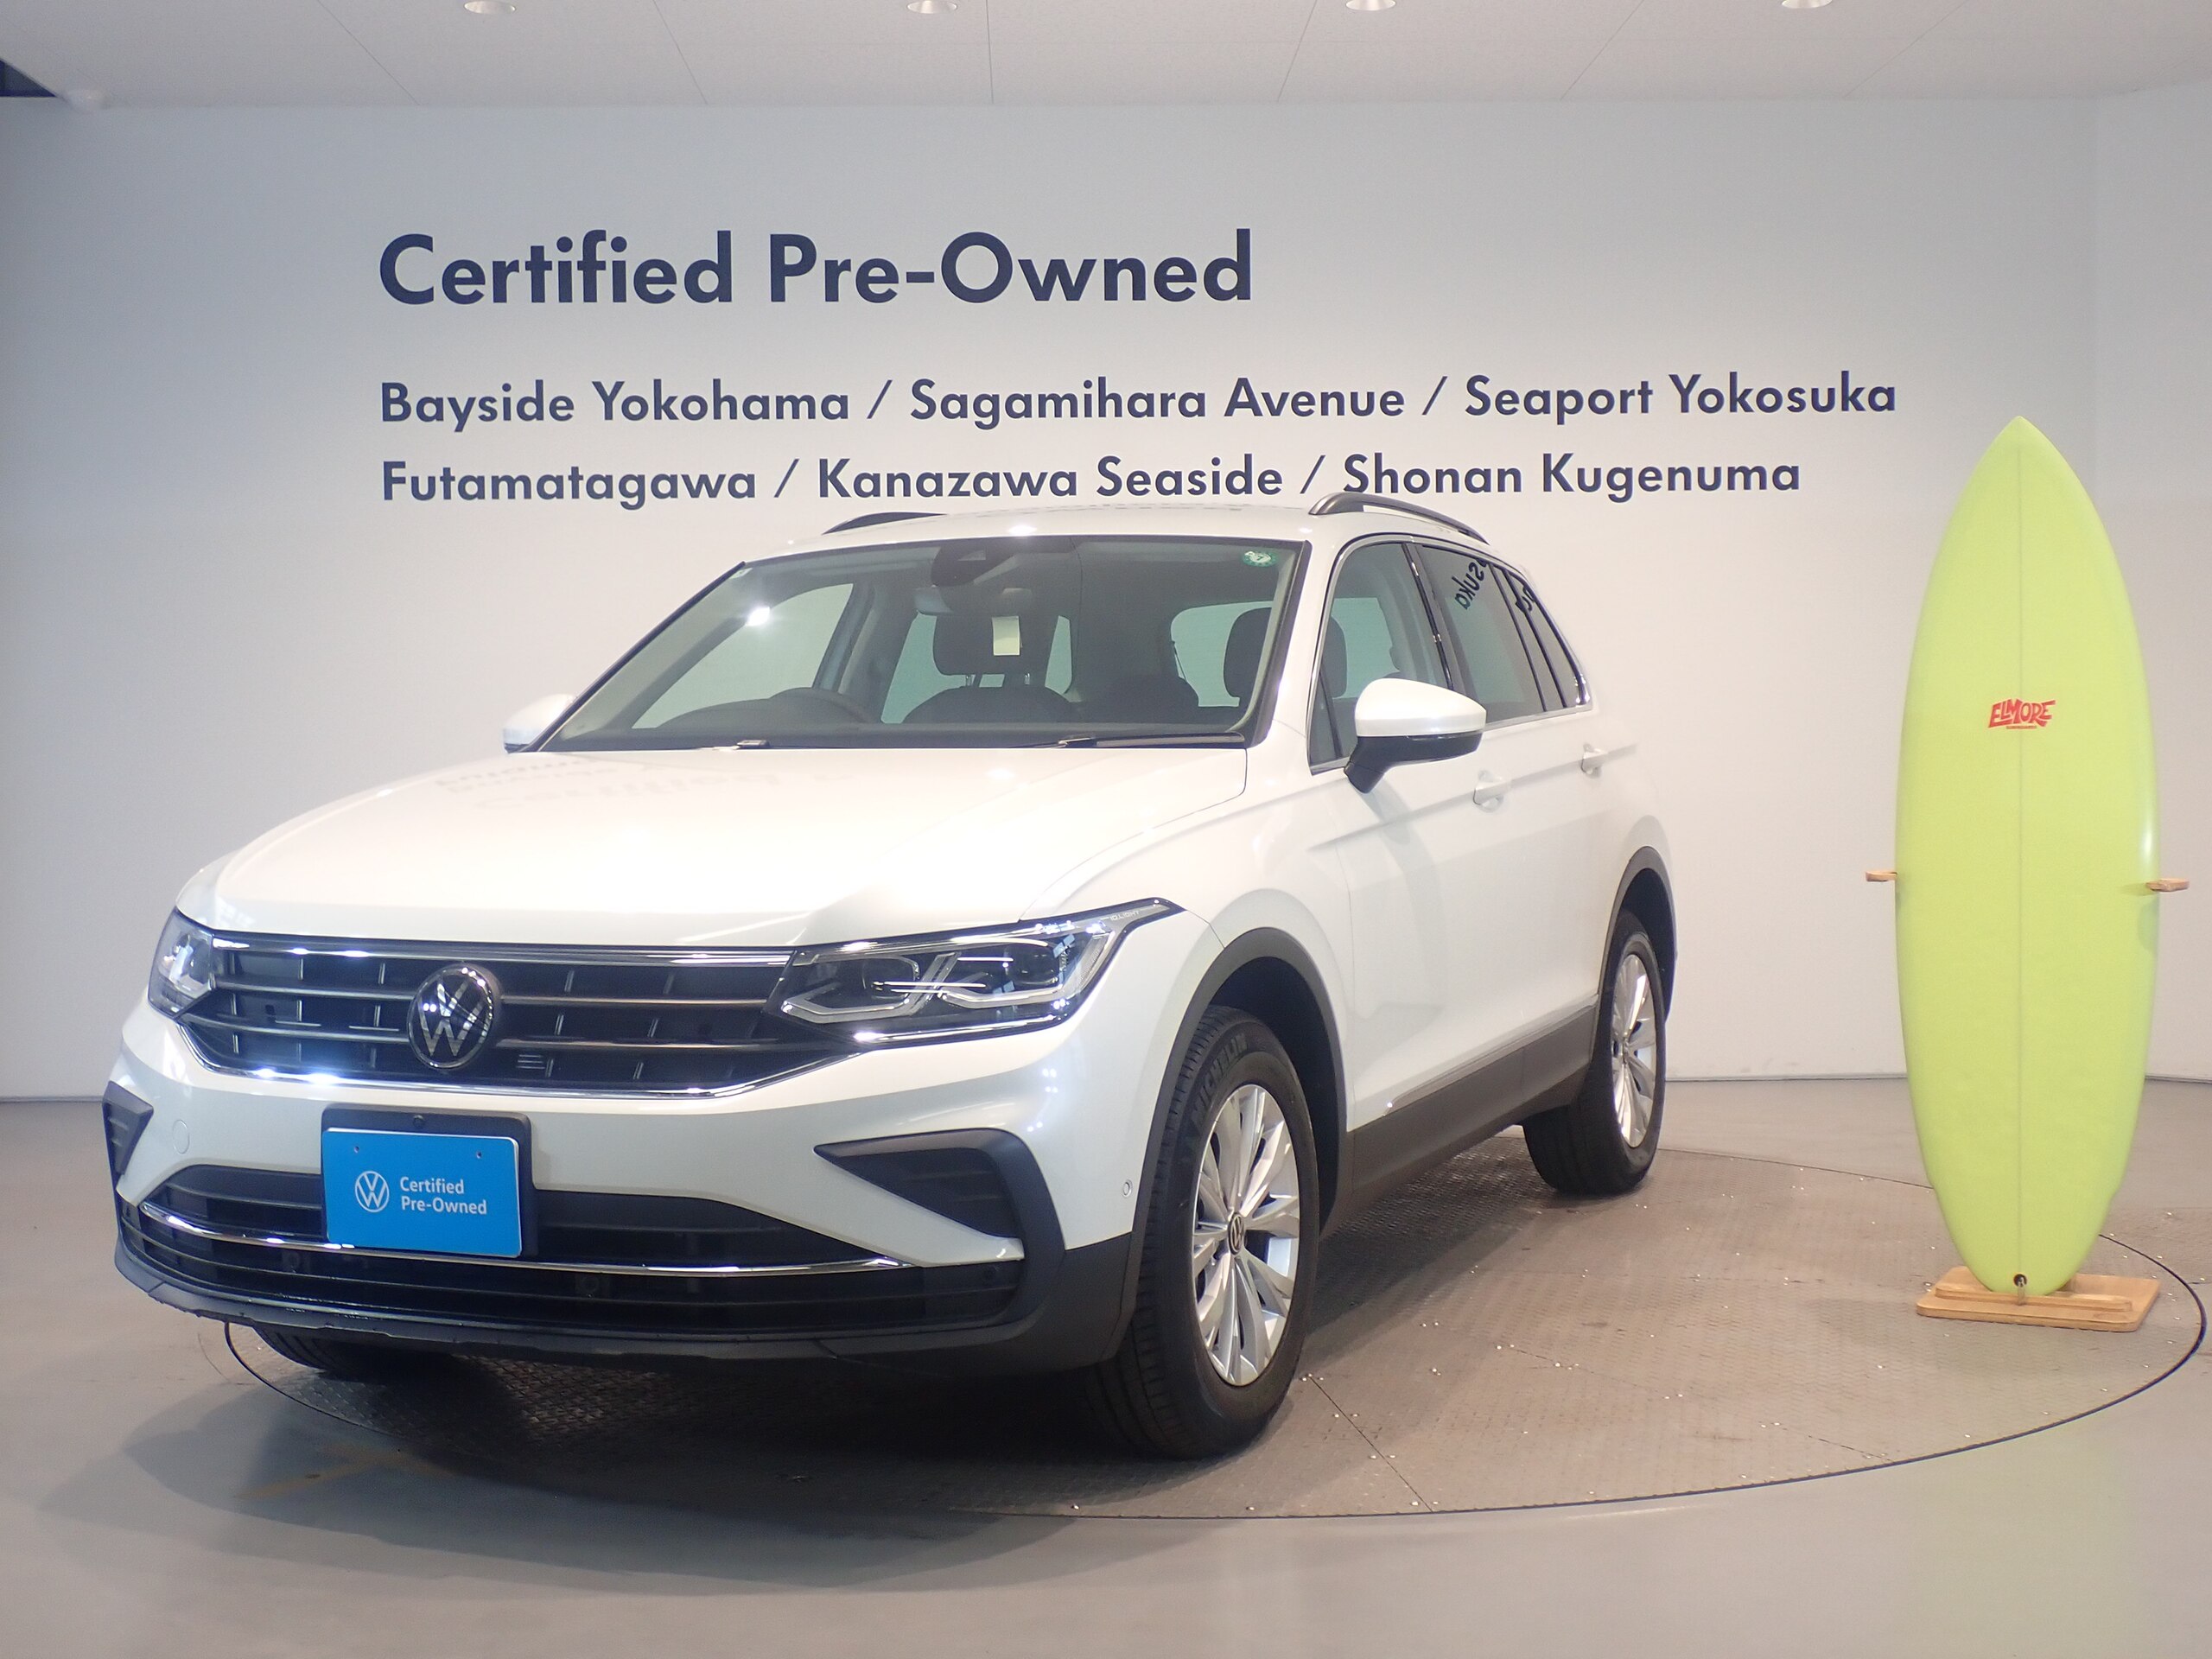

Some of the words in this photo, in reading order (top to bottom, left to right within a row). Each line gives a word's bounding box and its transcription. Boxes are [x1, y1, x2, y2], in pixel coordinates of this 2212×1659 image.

[380, 229, 733, 306] Certified
[769, 228, 1251, 304] Pre-Owned
[381, 379, 575, 433] Bayside
[591, 378, 849, 422] Yokohama
[867, 379, 893, 419] /
[910, 376, 1205, 430] Sagamihara
[1224, 377, 1405, 417] Avenue
[1421, 376, 1448, 416] /
[1465, 374, 1654, 426] Seaport
[1668, 370, 1896, 414] Yokosuka
[383, 461, 755, 511] Futamatagawa
[773, 458, 799, 499] /
[819, 458, 1077, 499] Kanazawa
[1096, 453, 1283, 497] Seaside
[1300, 454, 1325, 495] /
[1342, 452, 1522, 494] Shonan
[1542, 453, 1799, 504] Kugenuma
[1987, 698, 2056, 728] ELMORE
[1191, 1033, 1249, 1130] MICHELIN
[399, 1176, 465, 1194] Certified
[401, 1197, 487, 1215] Pre-Owned
